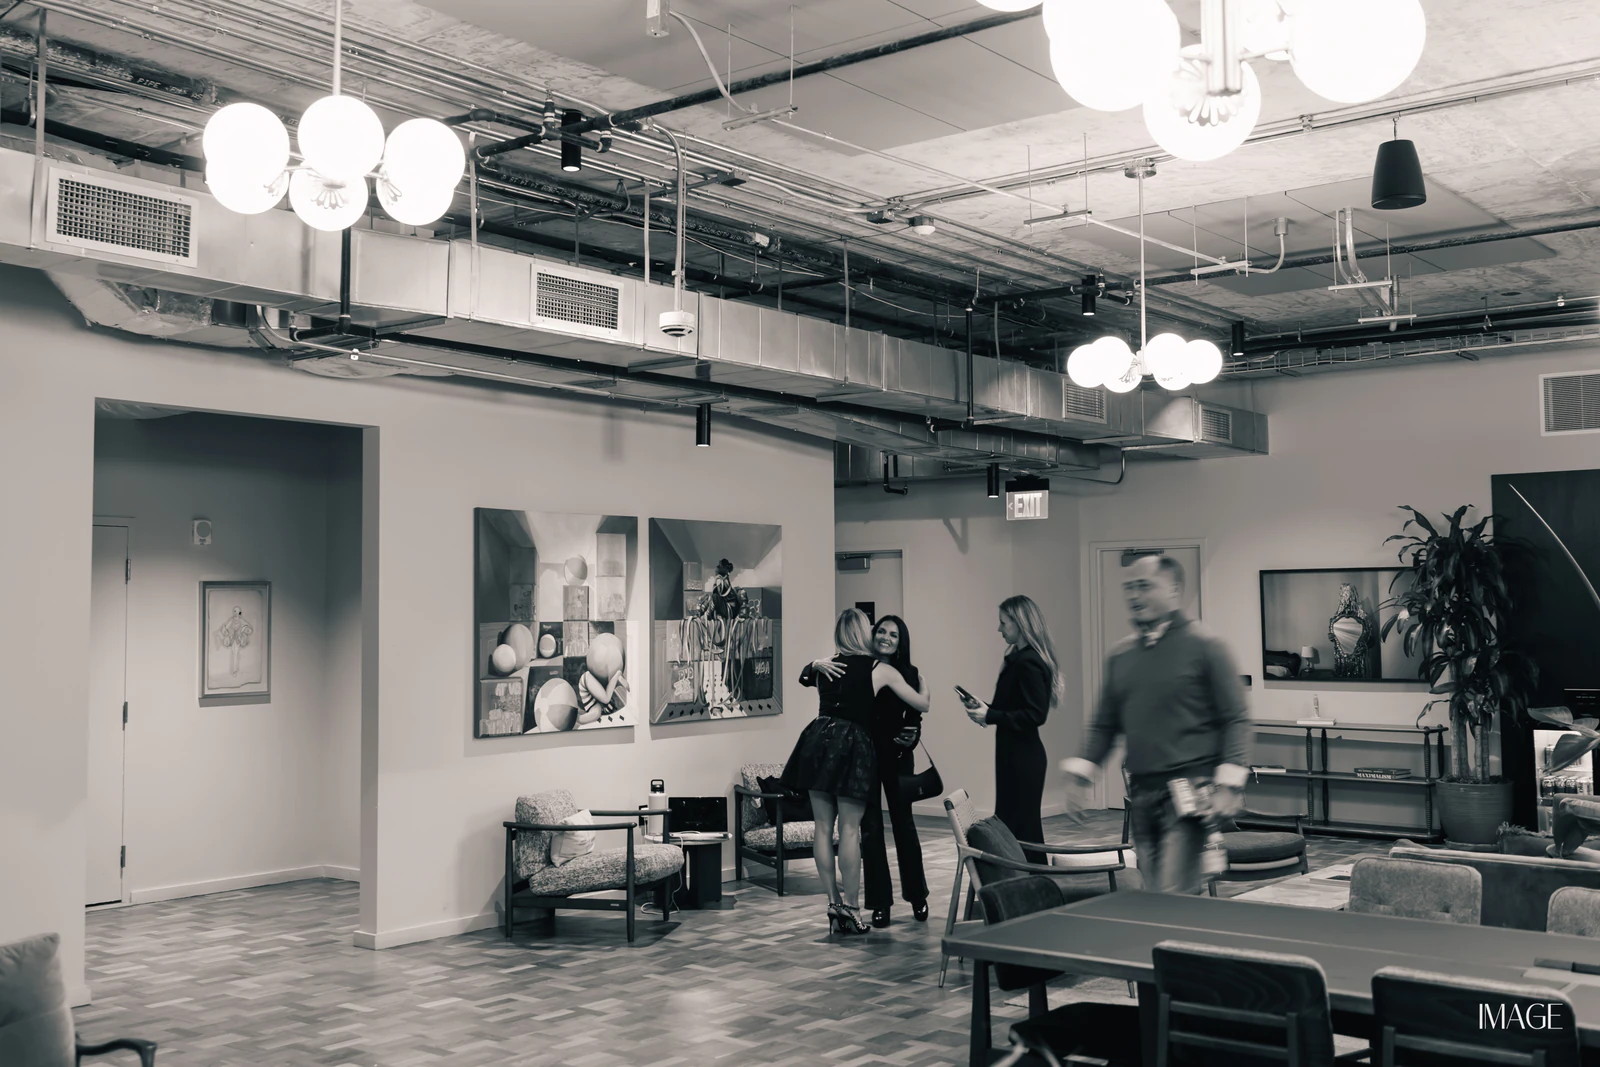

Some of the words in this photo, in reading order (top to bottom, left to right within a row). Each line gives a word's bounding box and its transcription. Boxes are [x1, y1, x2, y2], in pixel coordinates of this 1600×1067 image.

[136, 77, 161, 89] PIPE
[1014, 492, 1042, 518] EXIT
[1356, 772, 1392, 780] MAXIMALISM
